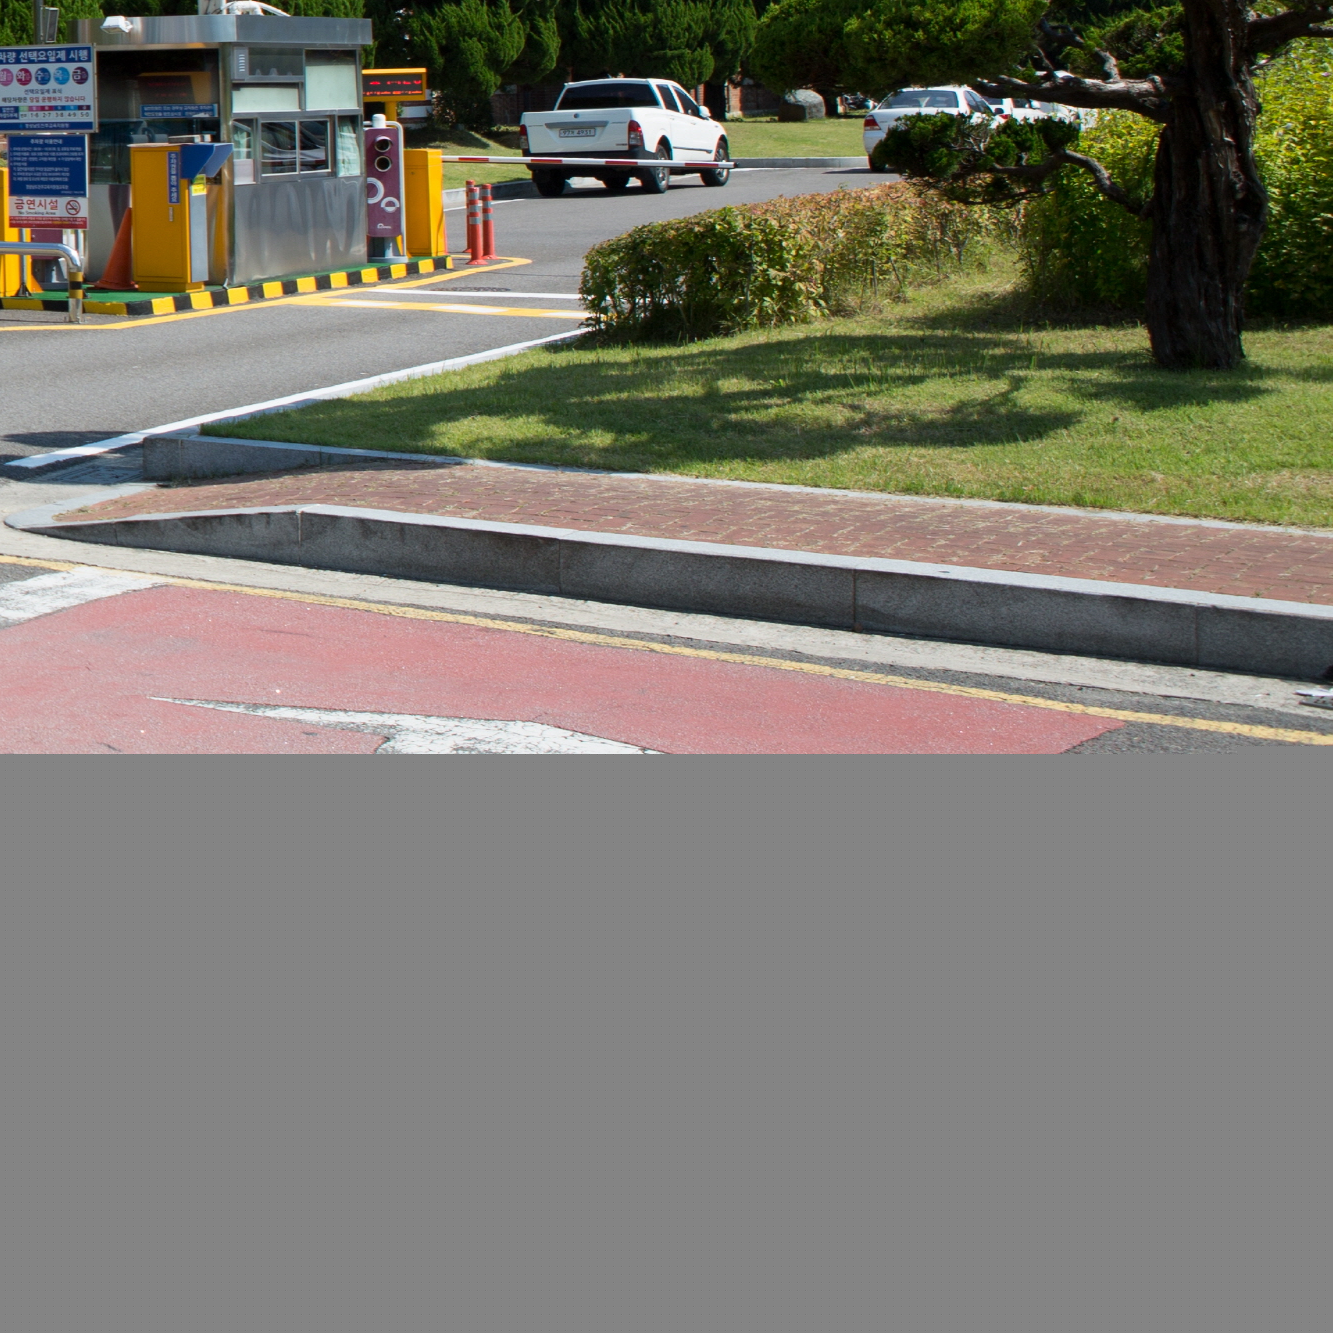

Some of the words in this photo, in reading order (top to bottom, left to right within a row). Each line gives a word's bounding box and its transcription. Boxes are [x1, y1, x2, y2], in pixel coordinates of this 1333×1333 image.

[19, 50, 66, 62] 선택요일제
[69, 49, 88, 61] 시행
[73, 69, 81, 80] 금
[14, 199, 58, 210] 금연시설
